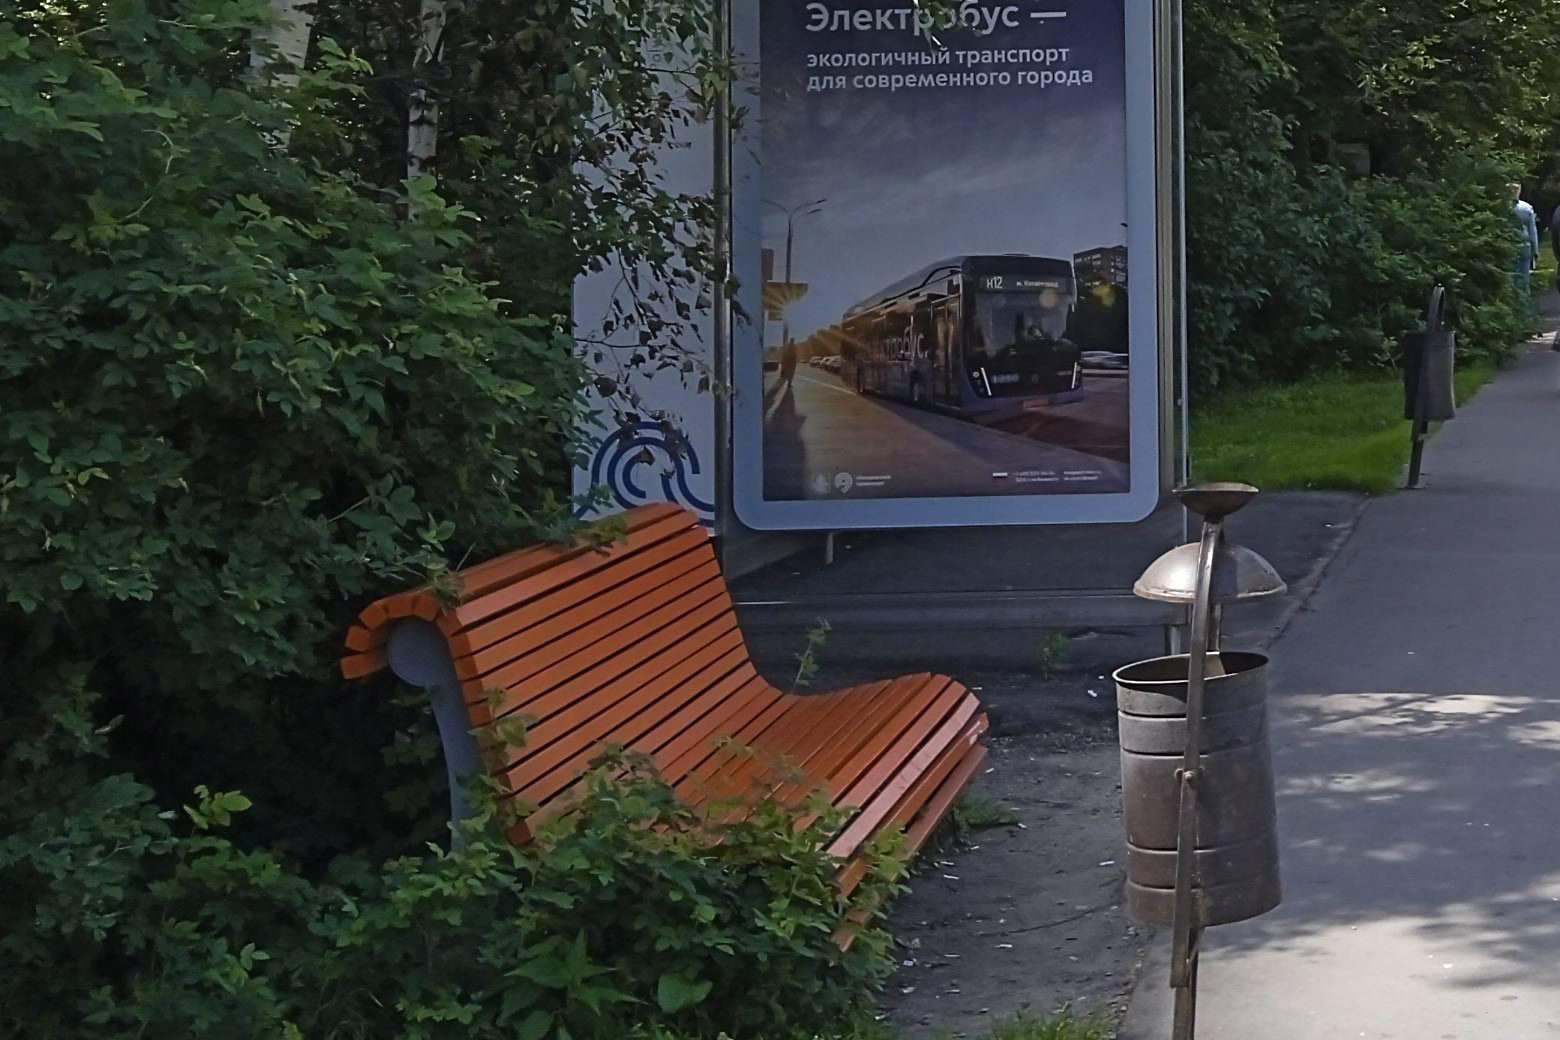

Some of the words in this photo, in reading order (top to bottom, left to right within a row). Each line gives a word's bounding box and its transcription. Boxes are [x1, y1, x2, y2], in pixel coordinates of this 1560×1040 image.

[806, 46, 951, 68] экологичный
[955, 48, 1070, 68] транспорт
[806, 74, 847, 92] для
[852, 70, 1011, 91] современного
[1017, 69, 1094, 88] города
